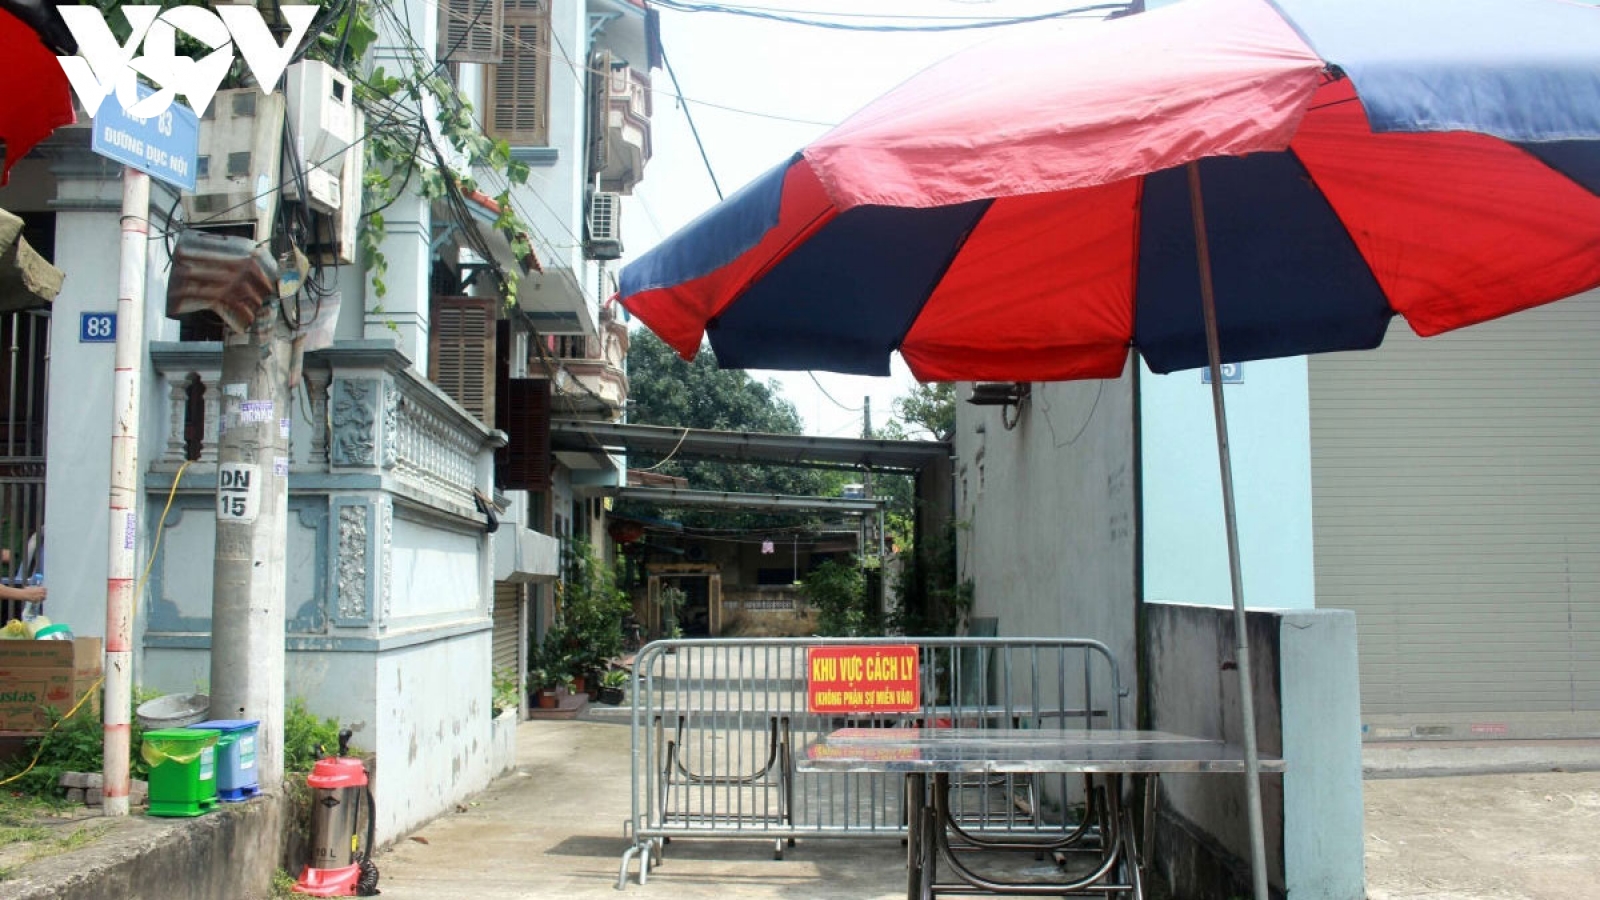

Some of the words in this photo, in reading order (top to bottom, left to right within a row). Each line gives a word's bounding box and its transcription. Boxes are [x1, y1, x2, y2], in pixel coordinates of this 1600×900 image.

[87, 316, 111, 337] 83
[221, 470, 250, 488] DN
[221, 495, 246, 517] 15
[813, 656, 837, 682] KHU
[840, 655, 863, 687] VỰC
[866, 652, 897, 681] CÁCH
[901, 656, 914, 681] LY
